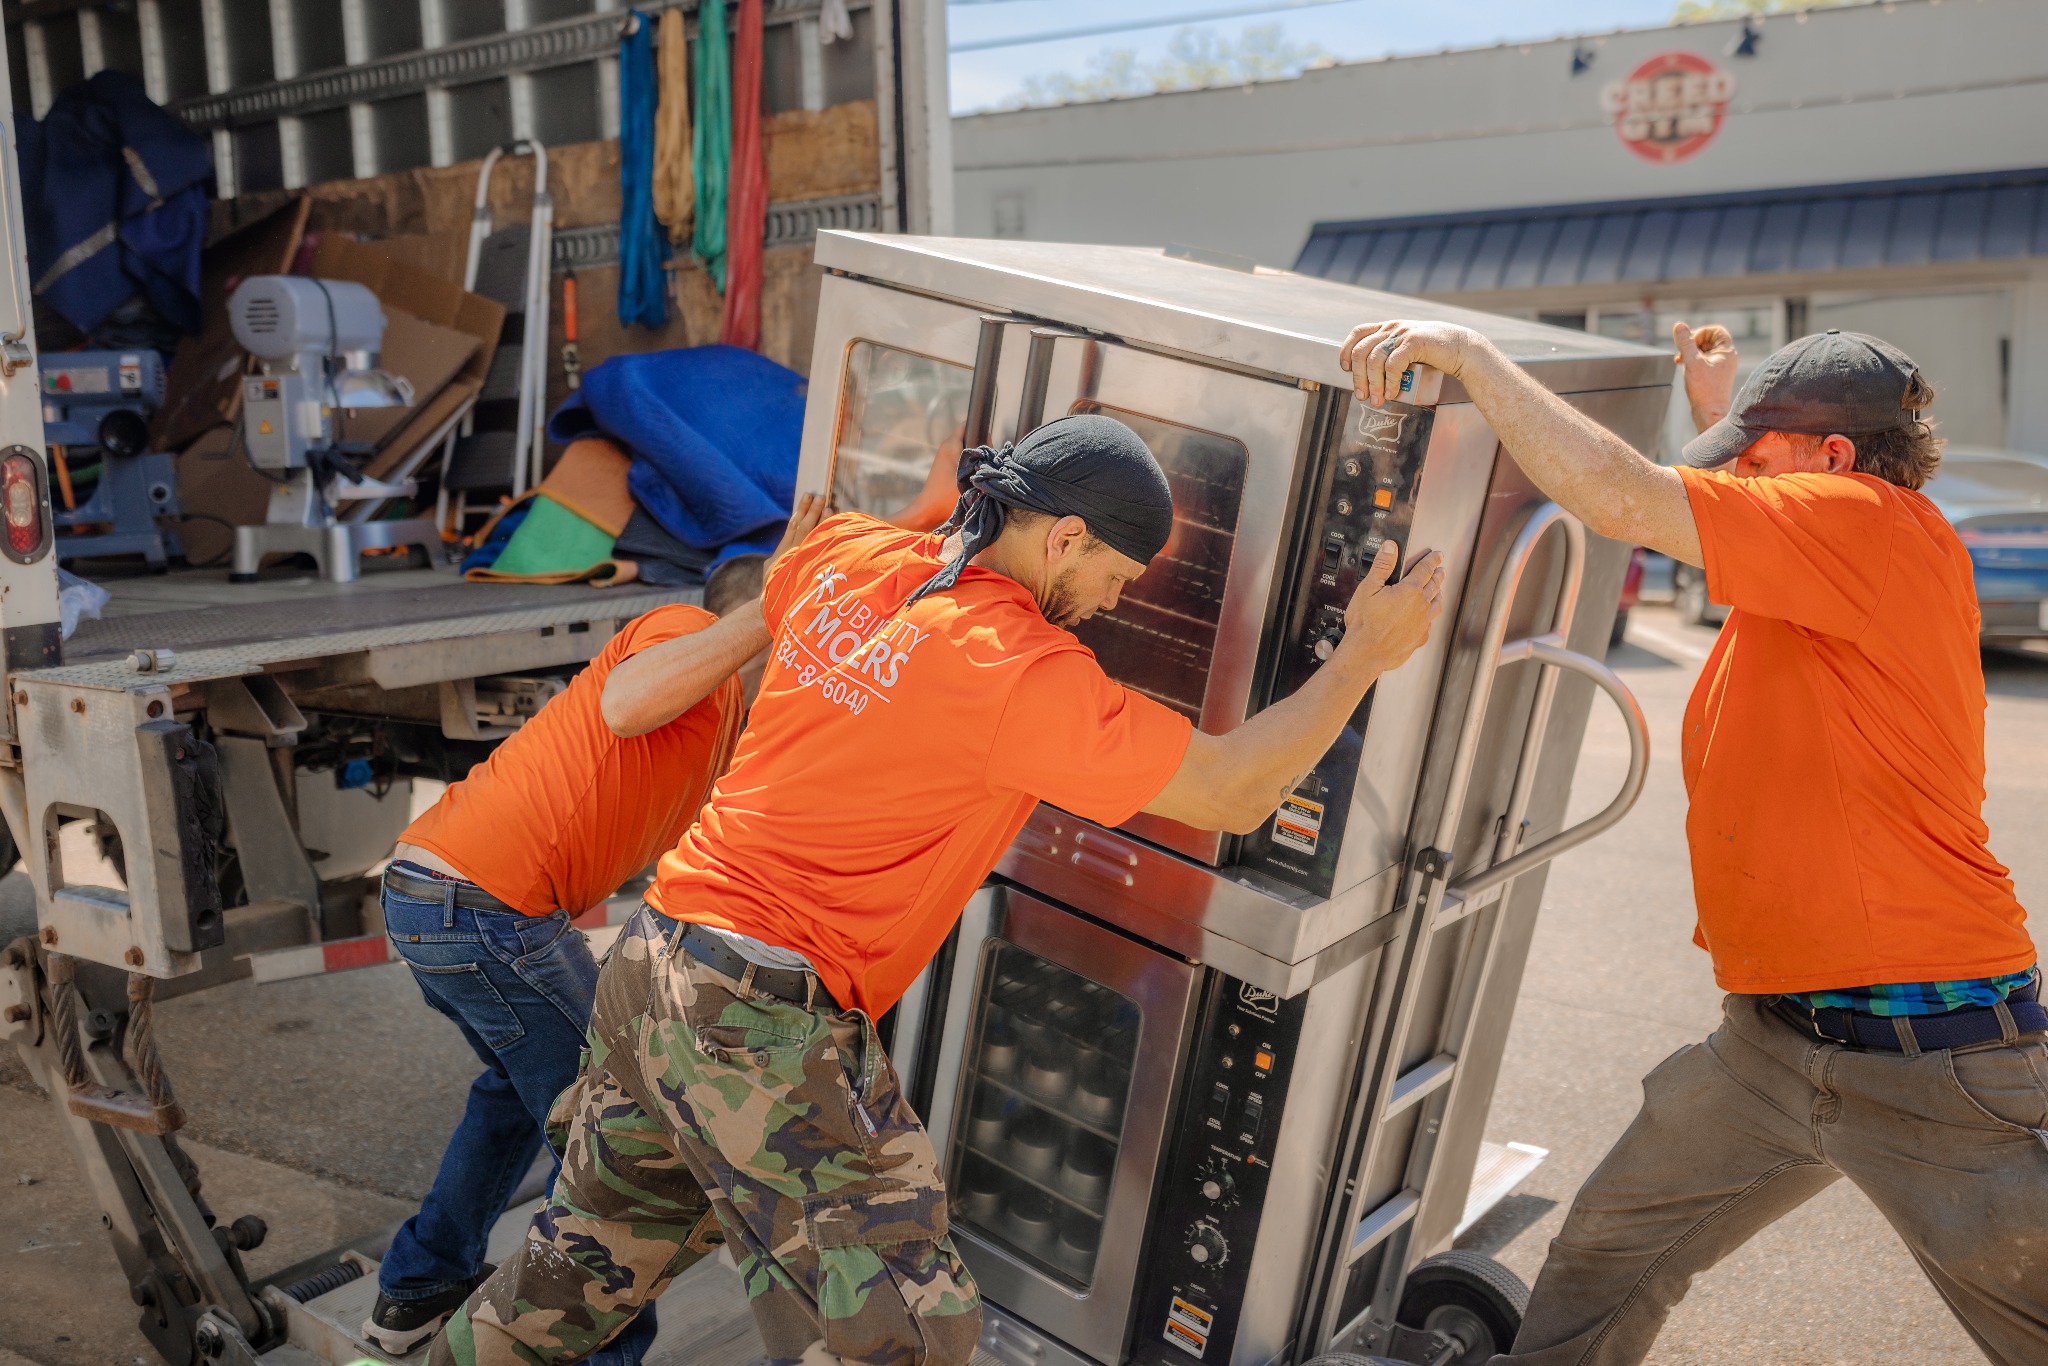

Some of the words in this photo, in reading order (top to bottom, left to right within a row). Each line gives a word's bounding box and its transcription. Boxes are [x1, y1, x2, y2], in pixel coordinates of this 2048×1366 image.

[1364, 414, 1398, 432] Duke
[1383, 477, 1393, 485] ON
[1374, 512, 1387, 520] OFF
[1330, 531, 1345, 540] COOK
[1322, 573, 1336, 582] COOL
[1320, 579, 1336, 587] DOWN
[802, 604, 910, 688] MOERS
[1244, 985, 1275, 1002] Duke
[1261, 1042, 1272, 1050] ON
[1254, 1071, 1267, 1080] OFF
[1215, 1081, 1229, 1091] COOK
[1247, 1095, 1263, 1105] SPEED
[1242, 1132, 1254, 1140] LOW
[1210, 1144, 1242, 1162] TEMPERATURE
